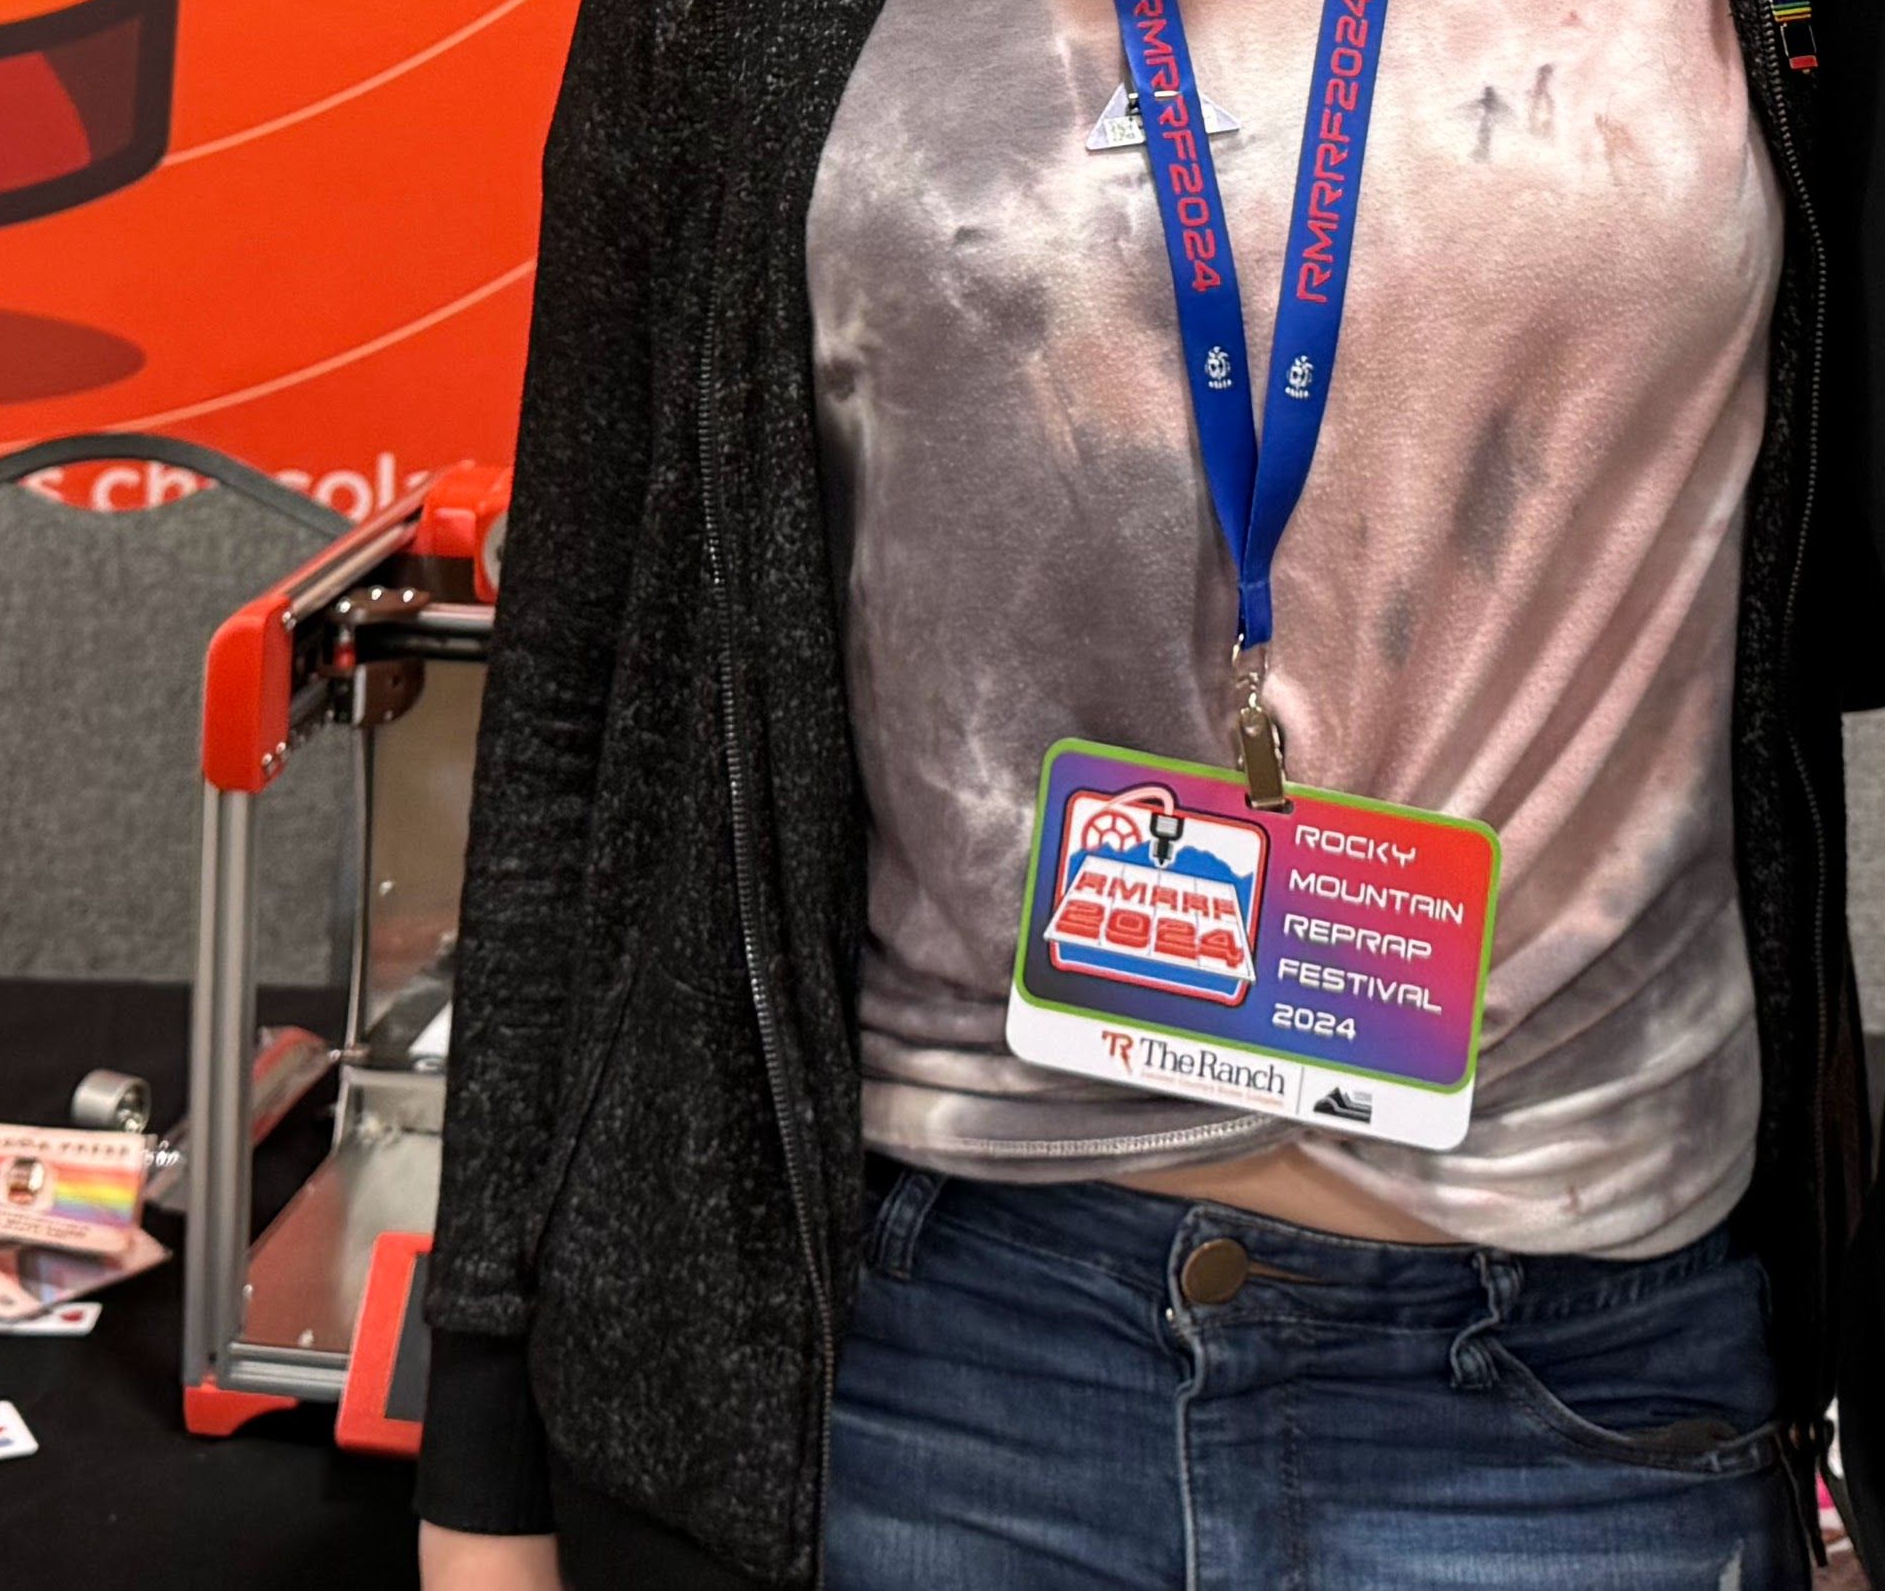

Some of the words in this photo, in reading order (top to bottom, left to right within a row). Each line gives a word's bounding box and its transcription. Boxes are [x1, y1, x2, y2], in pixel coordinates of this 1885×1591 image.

[1294, 824, 1417, 867] ROCKY
[1288, 867, 1465, 926] MOUNTAIN
[1054, 898, 1245, 970] 2024
[1282, 911, 1433, 961] REPRAP
[1276, 957, 1444, 1015] FESTIVAL
[1270, 1002, 1358, 1043] 2024
[1139, 1036, 1195, 1076] The
[1197, 1049, 1286, 1095] Ranch
